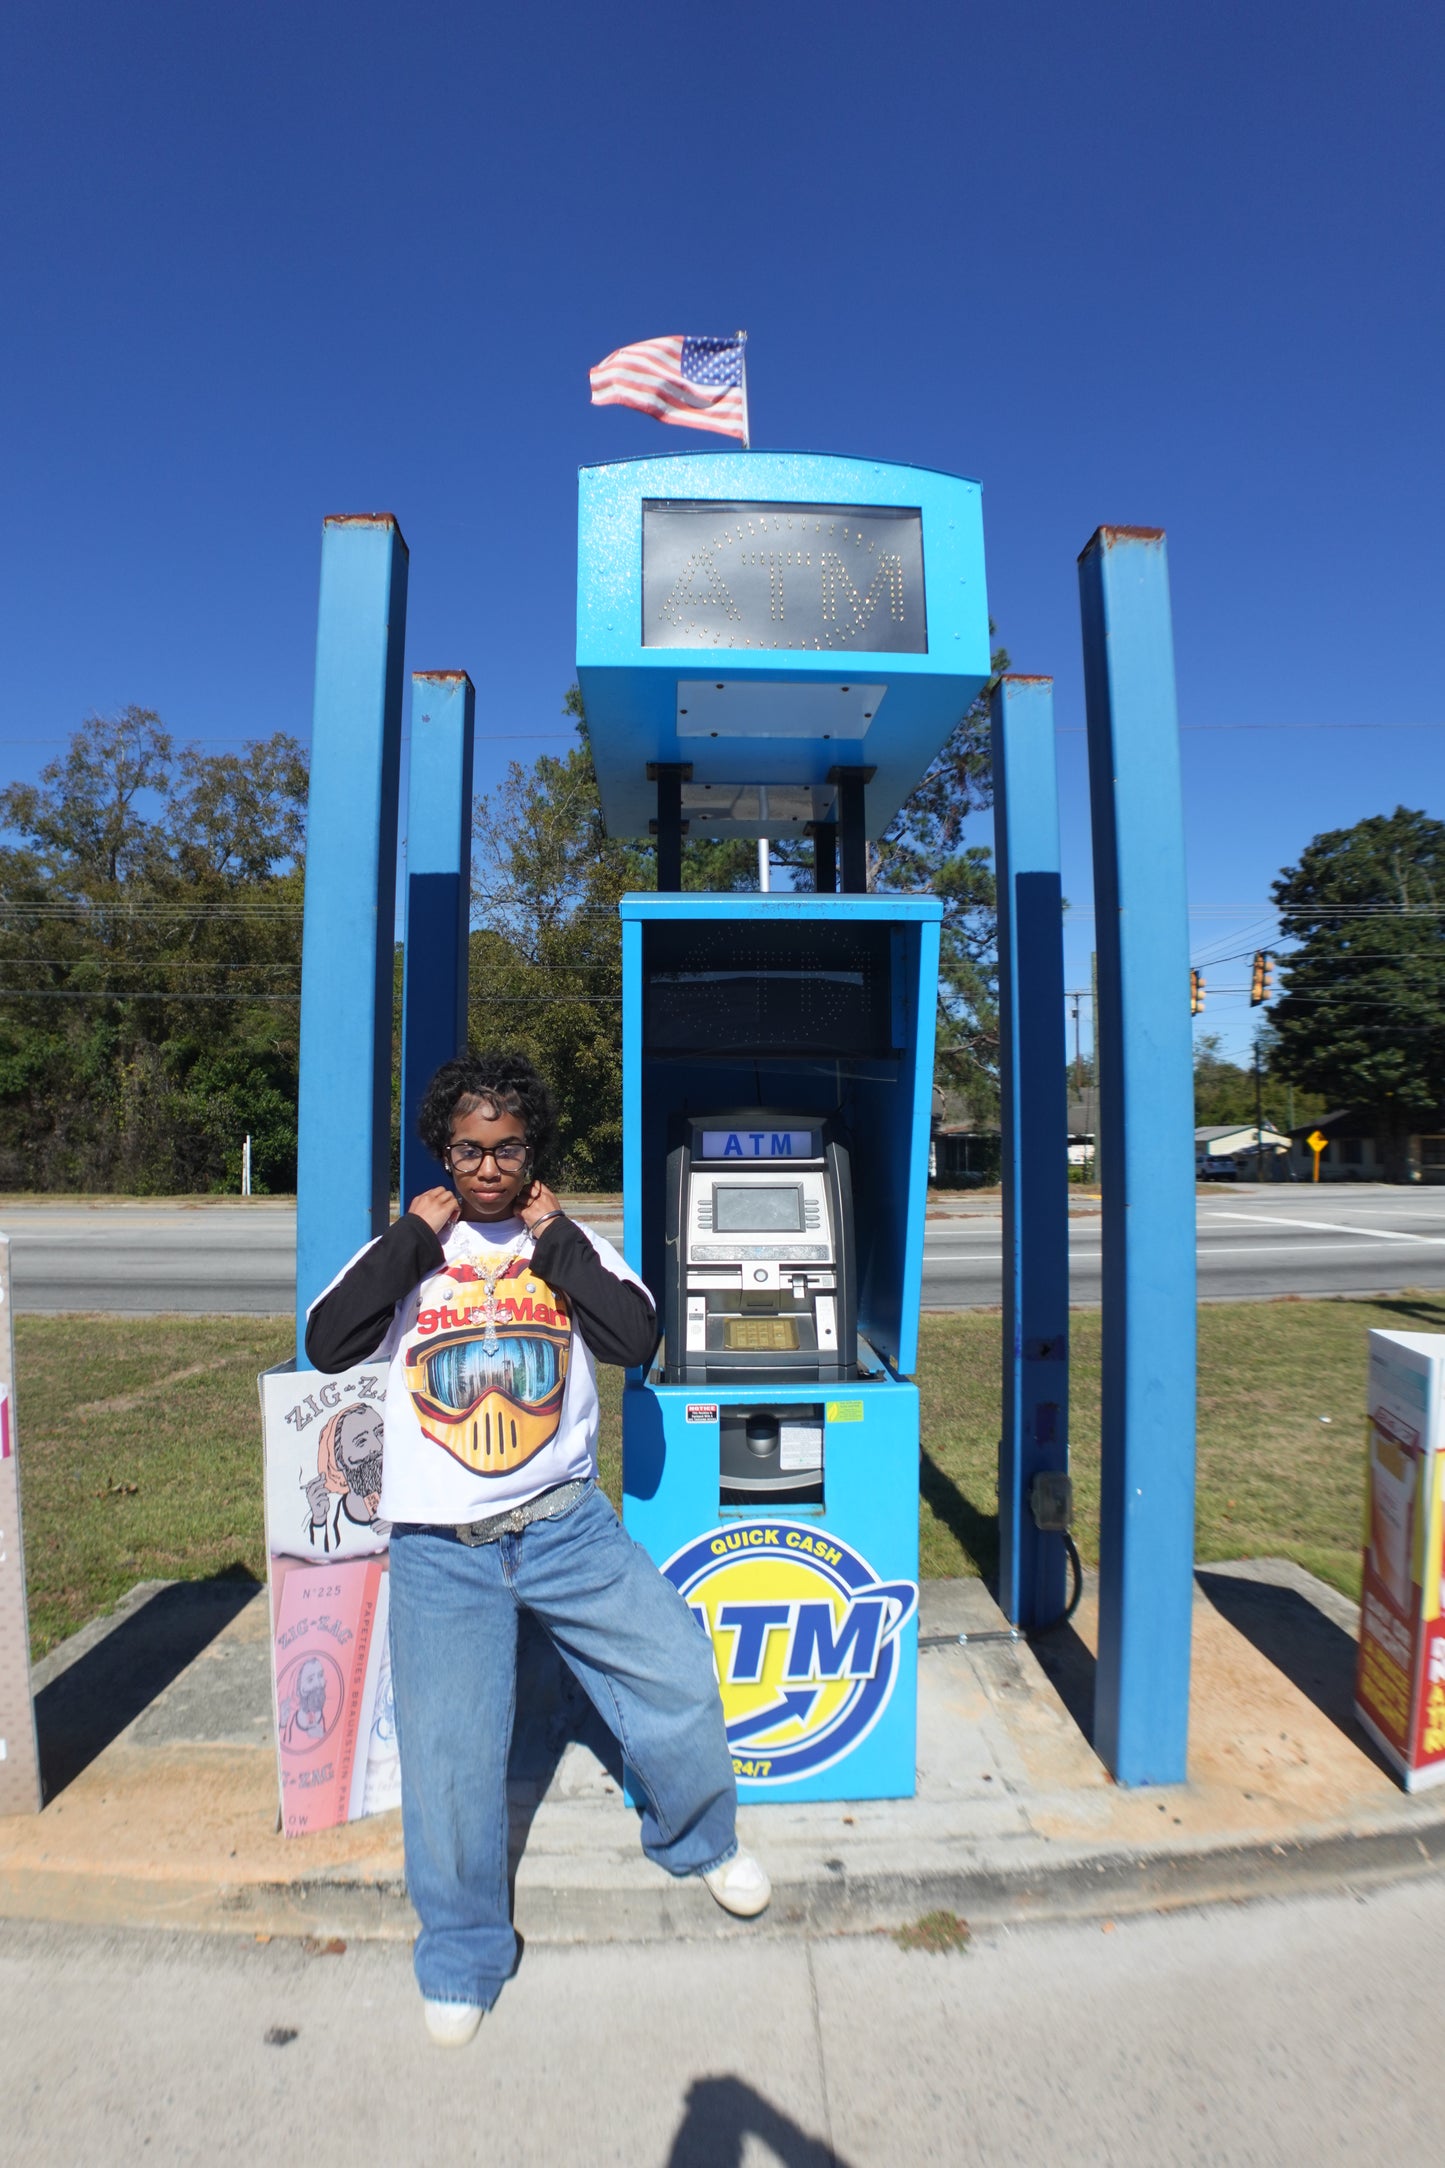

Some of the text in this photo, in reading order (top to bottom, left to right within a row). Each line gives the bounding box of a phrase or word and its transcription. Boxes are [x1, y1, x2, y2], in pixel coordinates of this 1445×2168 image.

[658, 551, 904, 622] ATM
[659, 950, 872, 1013] ATM
[724, 1134, 792, 1156] ATM
[711, 1529, 843, 1567] QUICK CASH
[277, 1615, 354, 1650] ZIG-ZAG
[353, 1601, 373, 1684] PAPETERIES
[688, 1600, 886, 1680] TM
[341, 1691, 359, 1779] BRAUNSTEIN
[731, 1759, 772, 1777] 24/7
